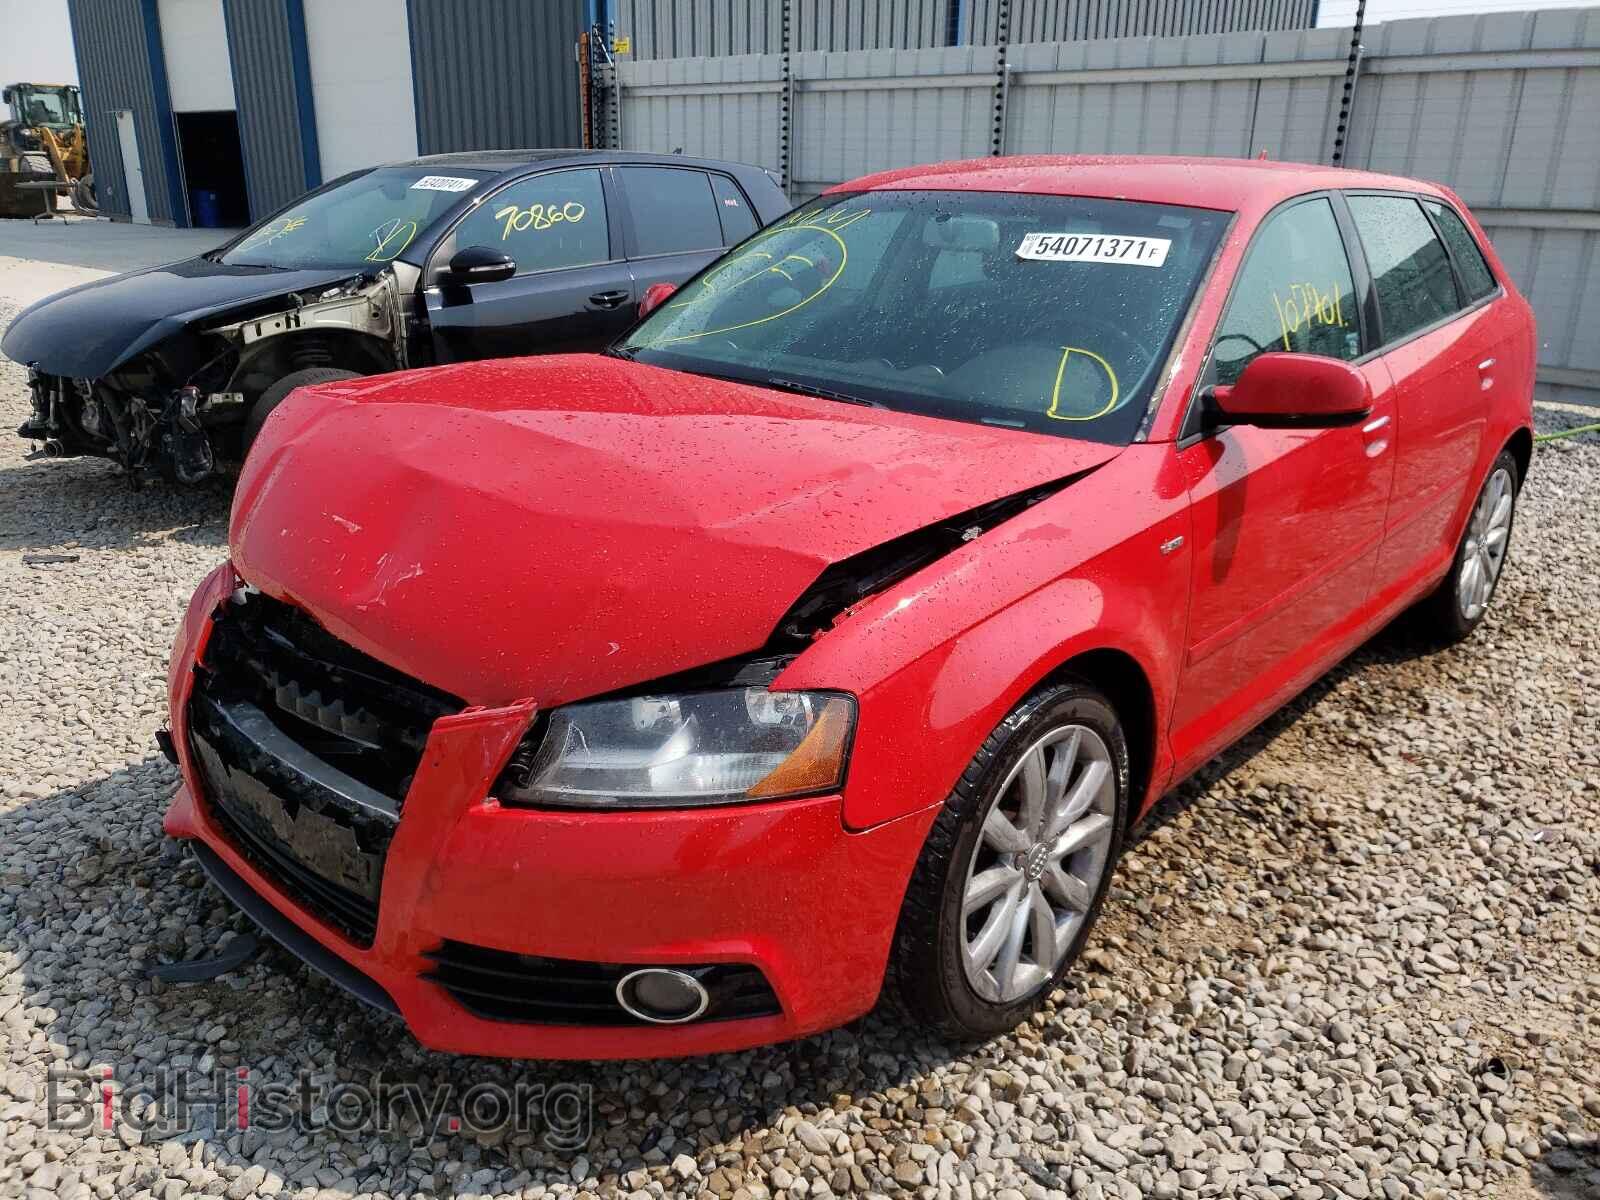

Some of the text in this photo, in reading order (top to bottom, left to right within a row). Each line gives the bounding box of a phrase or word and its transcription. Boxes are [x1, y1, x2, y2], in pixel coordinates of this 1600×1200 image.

[495, 202, 585, 240] 70860
[1035, 236, 1147, 259] 54071371
[1149, 247, 1159, 258] F
[1046, 346, 1119, 420] D
